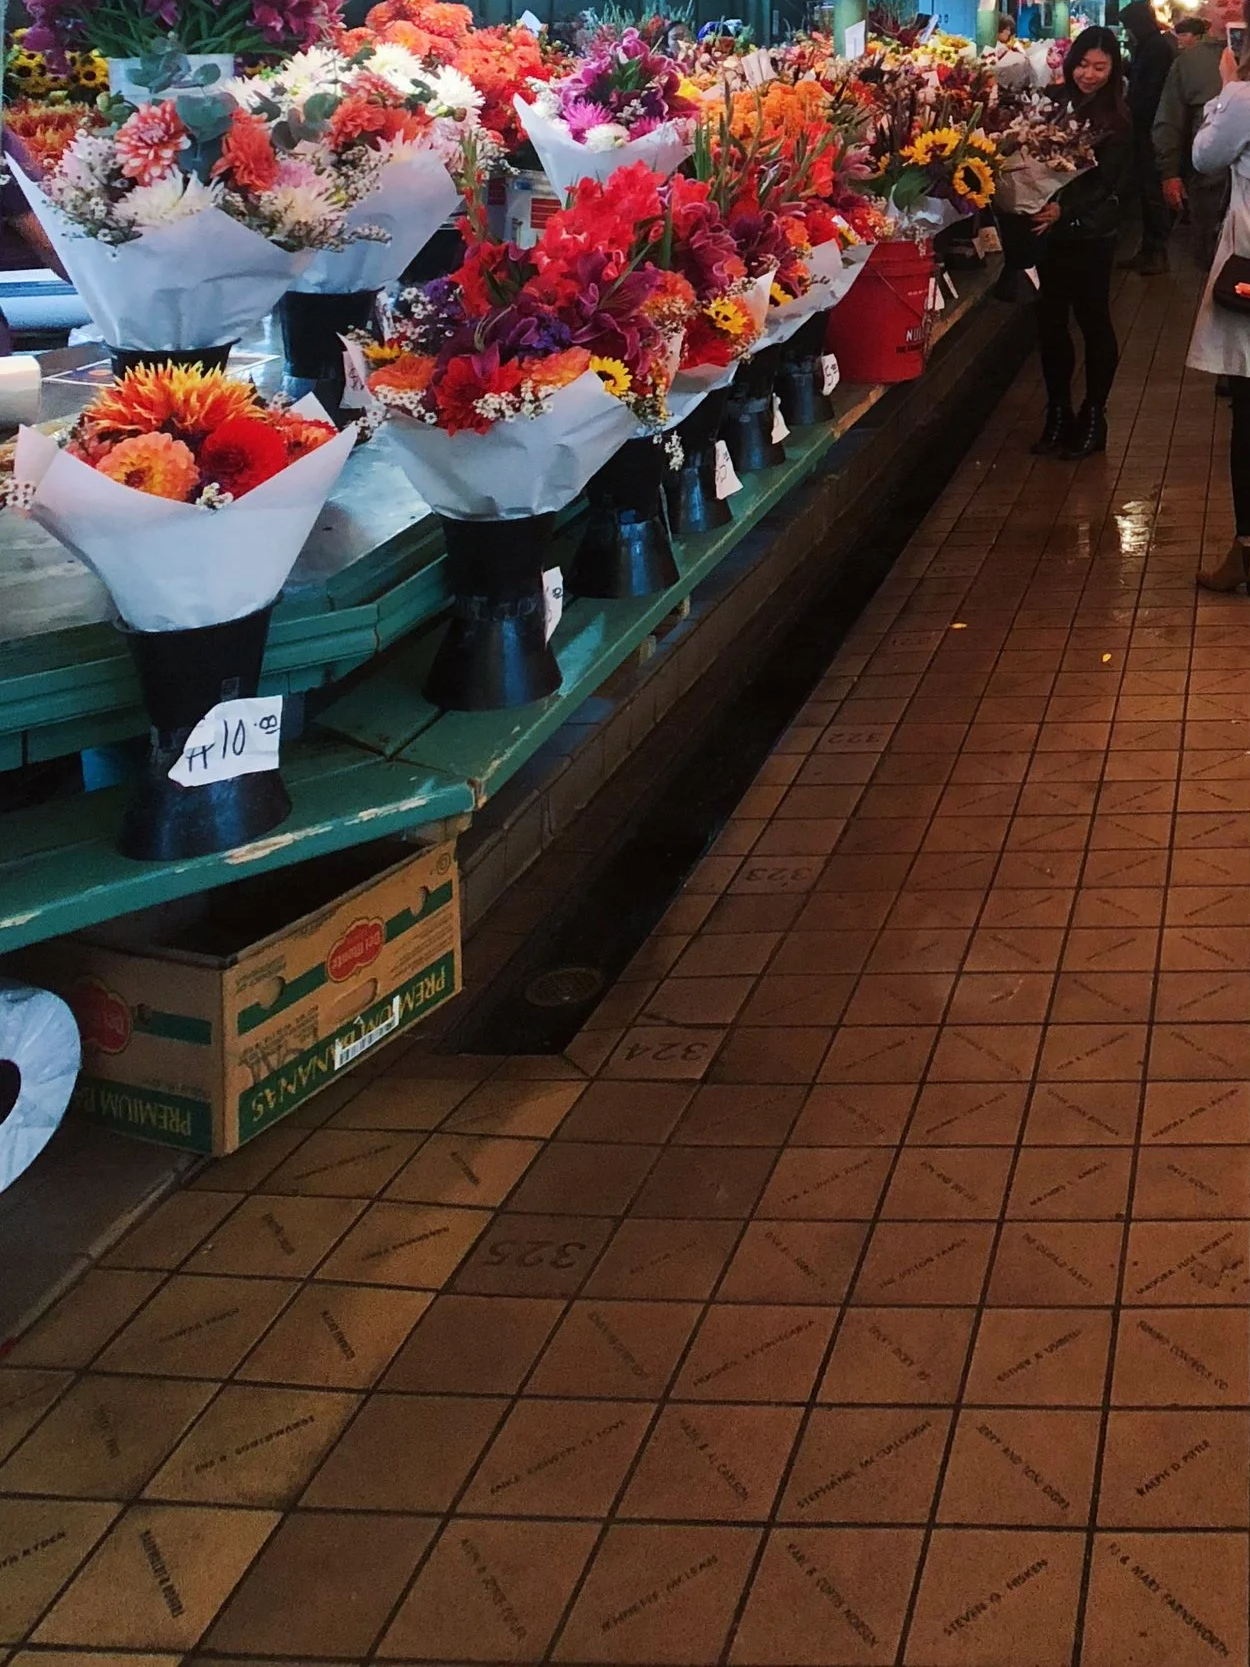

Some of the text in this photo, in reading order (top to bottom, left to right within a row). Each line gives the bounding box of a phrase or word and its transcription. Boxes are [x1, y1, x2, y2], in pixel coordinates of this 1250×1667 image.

[741, 866, 813, 885] 323
[622, 1041, 709, 1064] 324
[484, 1241, 586, 1269] 325
